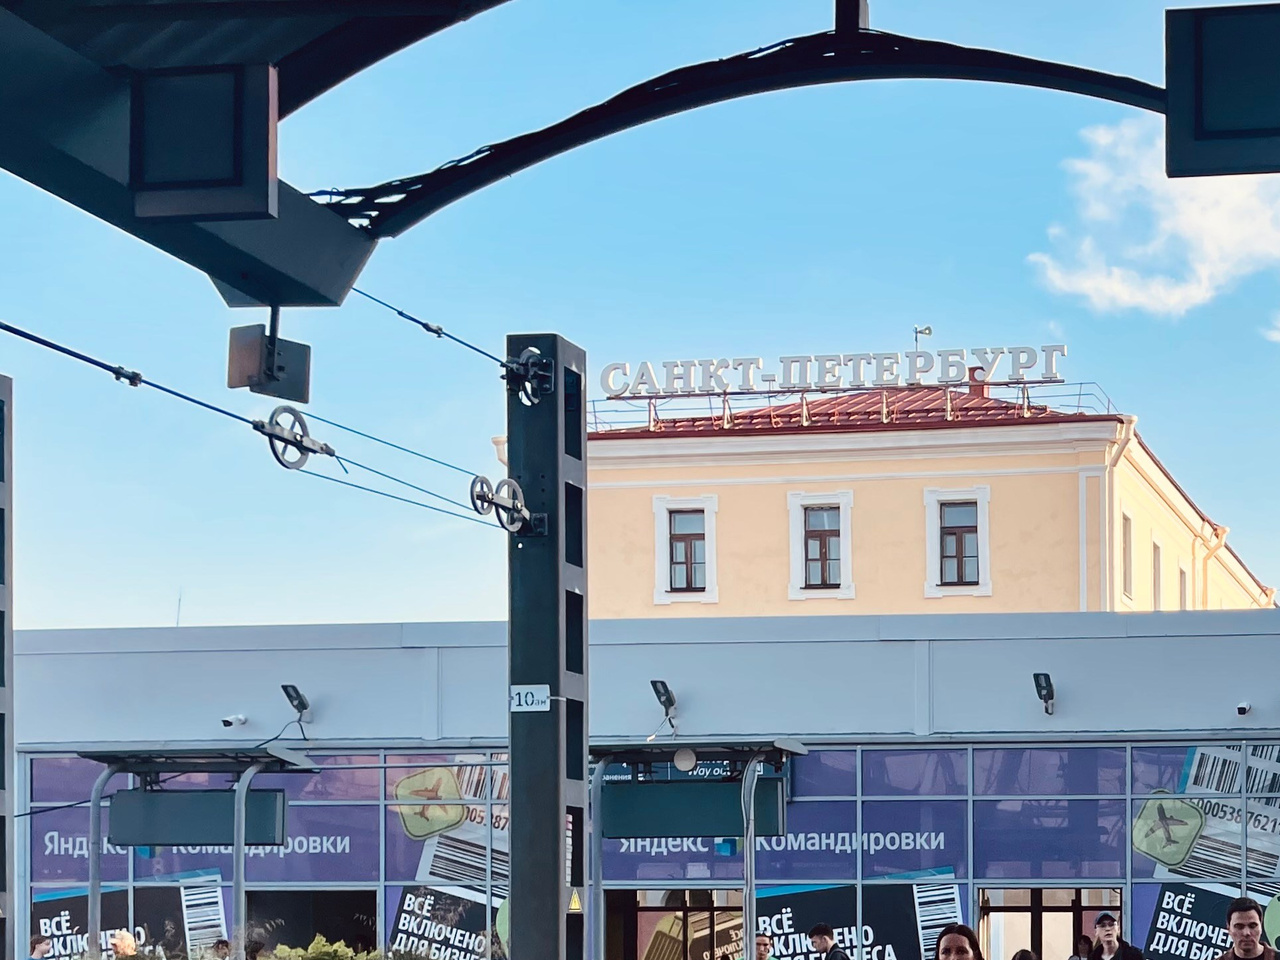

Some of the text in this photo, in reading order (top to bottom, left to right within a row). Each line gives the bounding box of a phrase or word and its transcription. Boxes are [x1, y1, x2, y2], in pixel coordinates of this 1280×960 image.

[601, 344, 1067, 397] САНКТ-ПЕТЕРБУРГ
[620, 831, 945, 856] Яндекс Командировки
[403, 893, 435, 917] ВСЁ
[1161, 891, 1196, 915] ВСЁ
[40, 910, 72, 937] ВСЁ
[398, 912, 487, 953] ВКЛЮЧЕНО
[758, 907, 795, 936] ВСЁ
[392, 932, 429, 957] ДЛЯ
[768, 925, 875, 957] КЛЮЕНО
[1149, 931, 1190, 958] ДЛЯ
